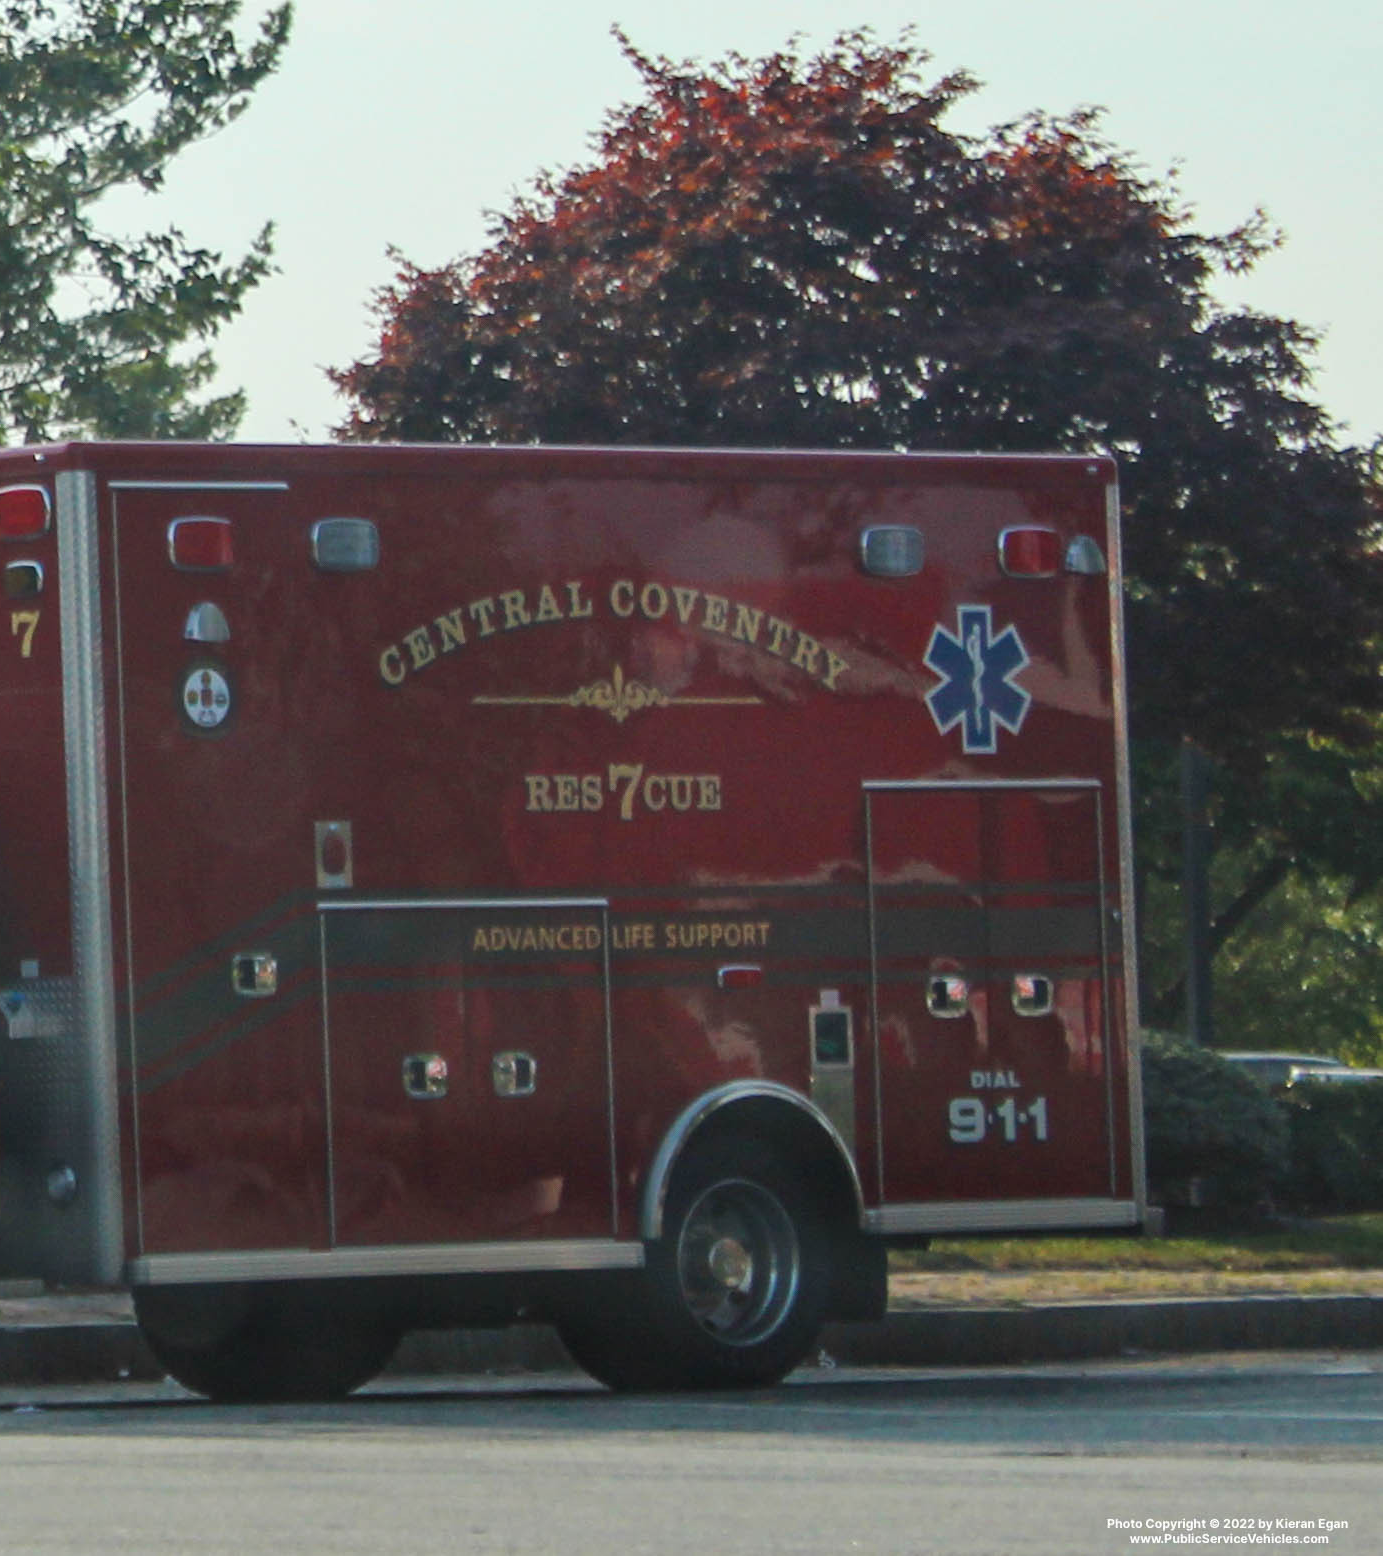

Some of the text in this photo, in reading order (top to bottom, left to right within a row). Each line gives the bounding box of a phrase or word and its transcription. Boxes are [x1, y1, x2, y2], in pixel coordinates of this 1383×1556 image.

[11, 611, 41, 658] 7
[378, 580, 851, 690] CENTRAL COVENTRY
[473, 922, 771, 951] ADVANCED LIFE SUPPORT
[970, 1069, 1022, 1089] DIAL
